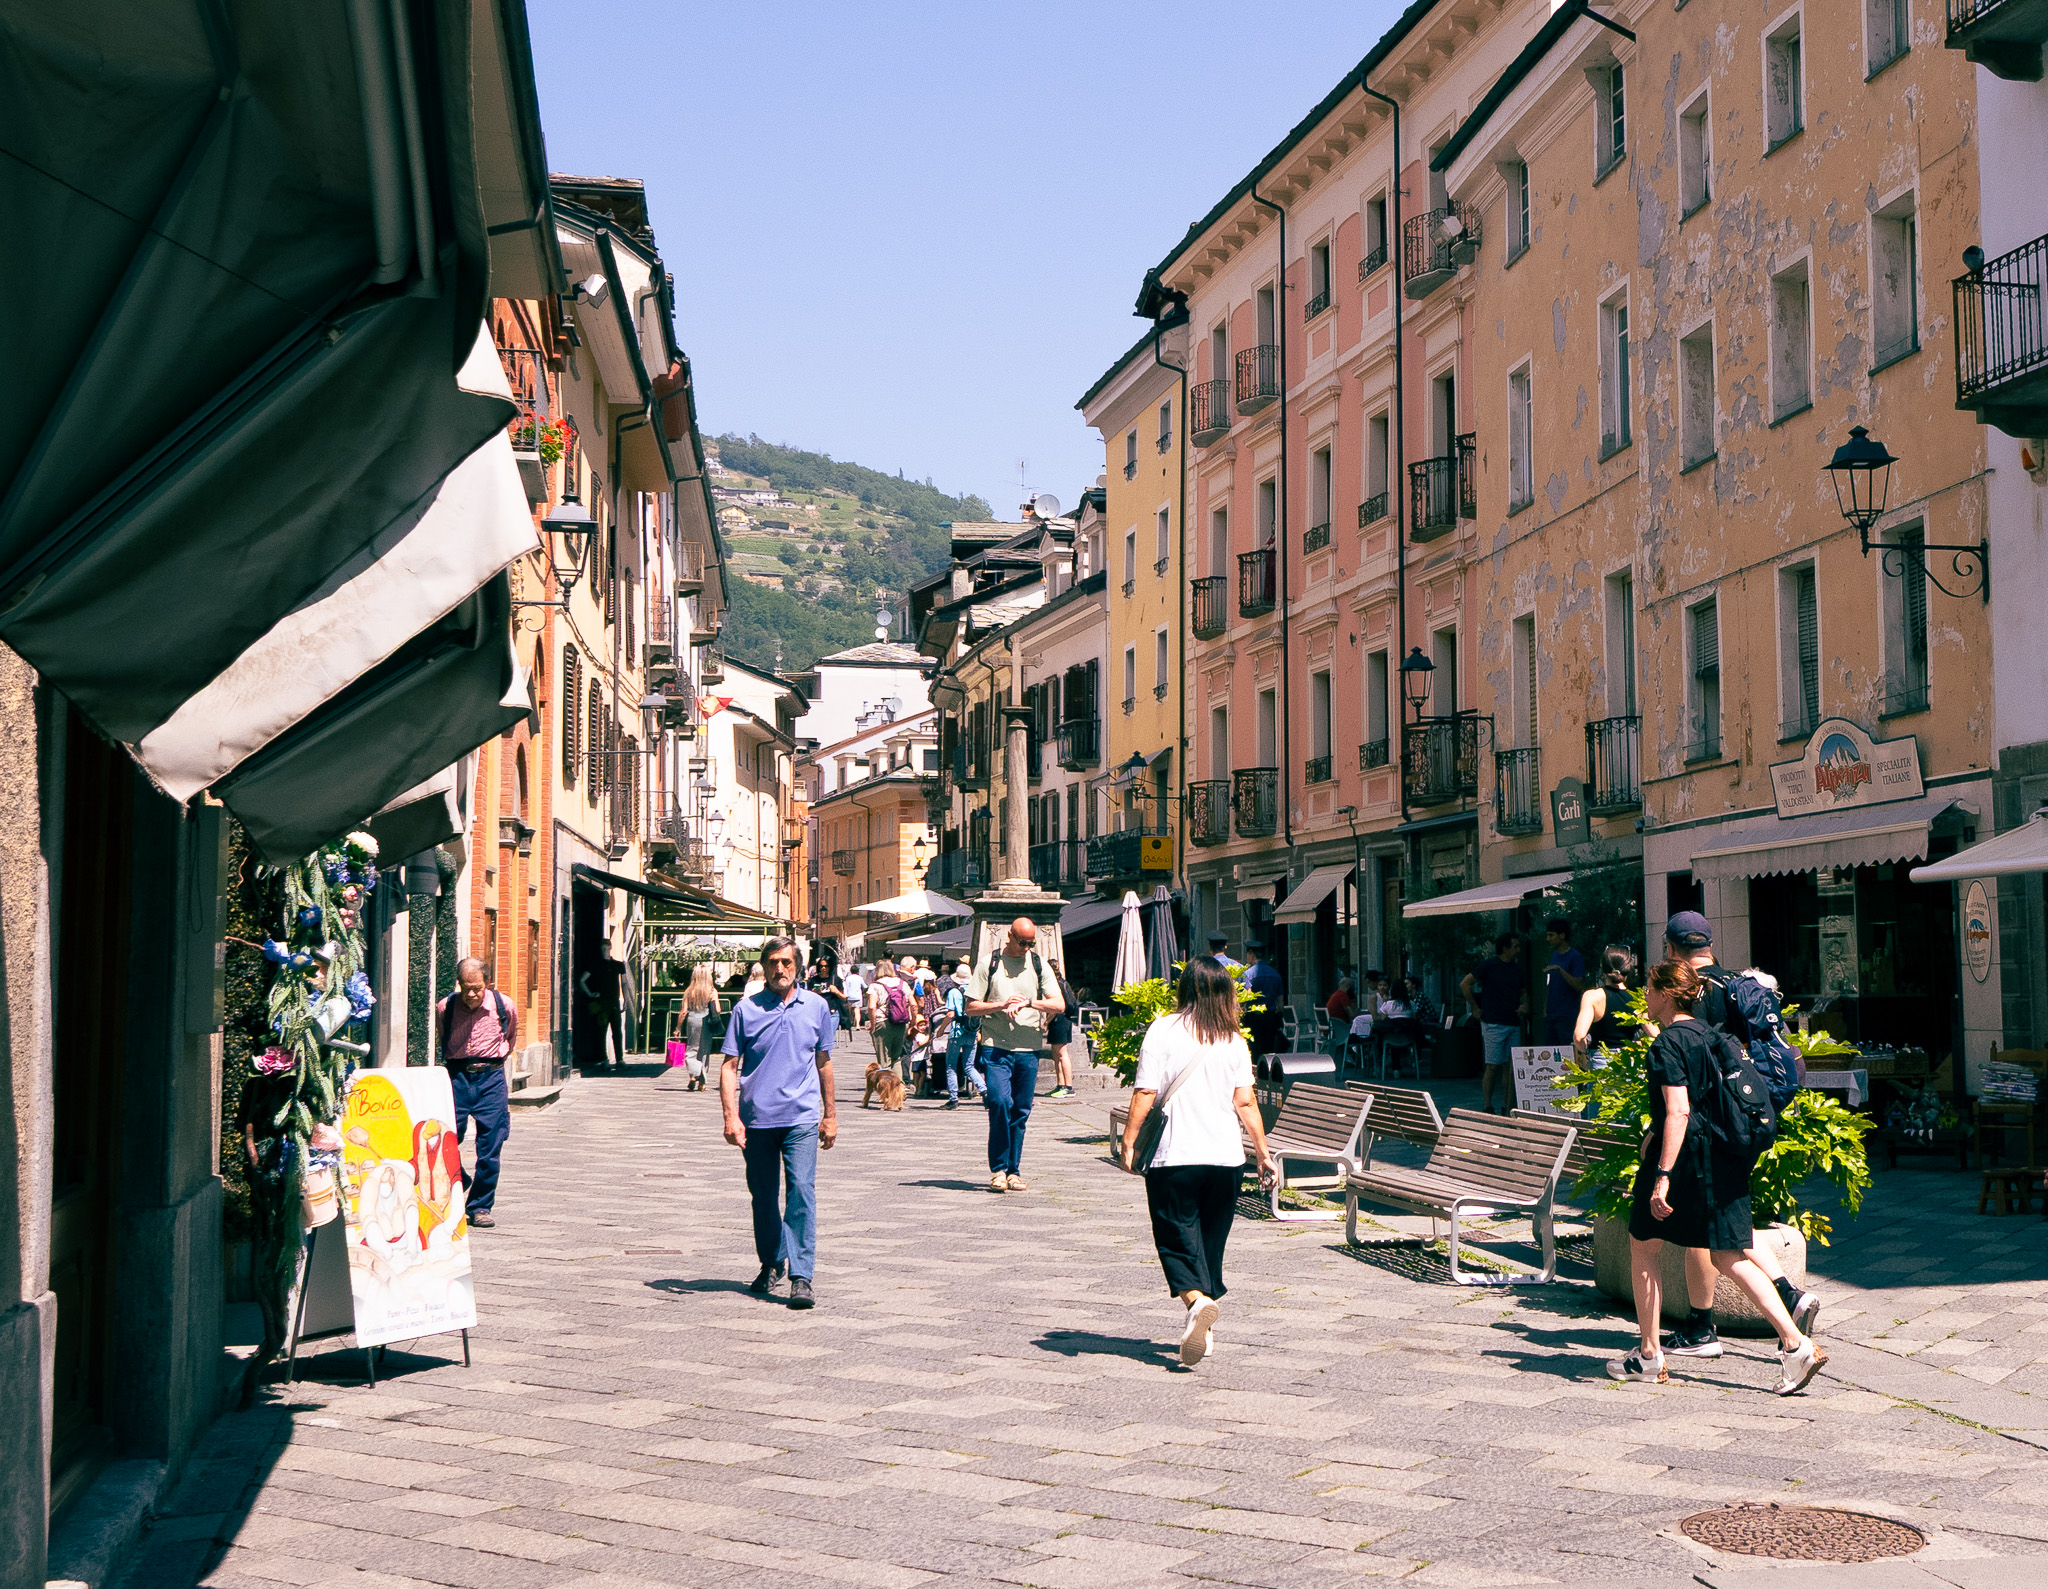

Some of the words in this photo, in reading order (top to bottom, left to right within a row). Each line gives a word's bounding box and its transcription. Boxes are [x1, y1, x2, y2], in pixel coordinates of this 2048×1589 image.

[1779, 769, 1807, 783] PRODOTTI
[1881, 771, 1911, 785] ITALIANE
[1787, 783, 1804, 795] TIPICI
[1781, 795, 1814, 808] VALDOSTANI
[1558, 800, 1581, 821] Carli
[358, 1089, 402, 1117] Bovio
